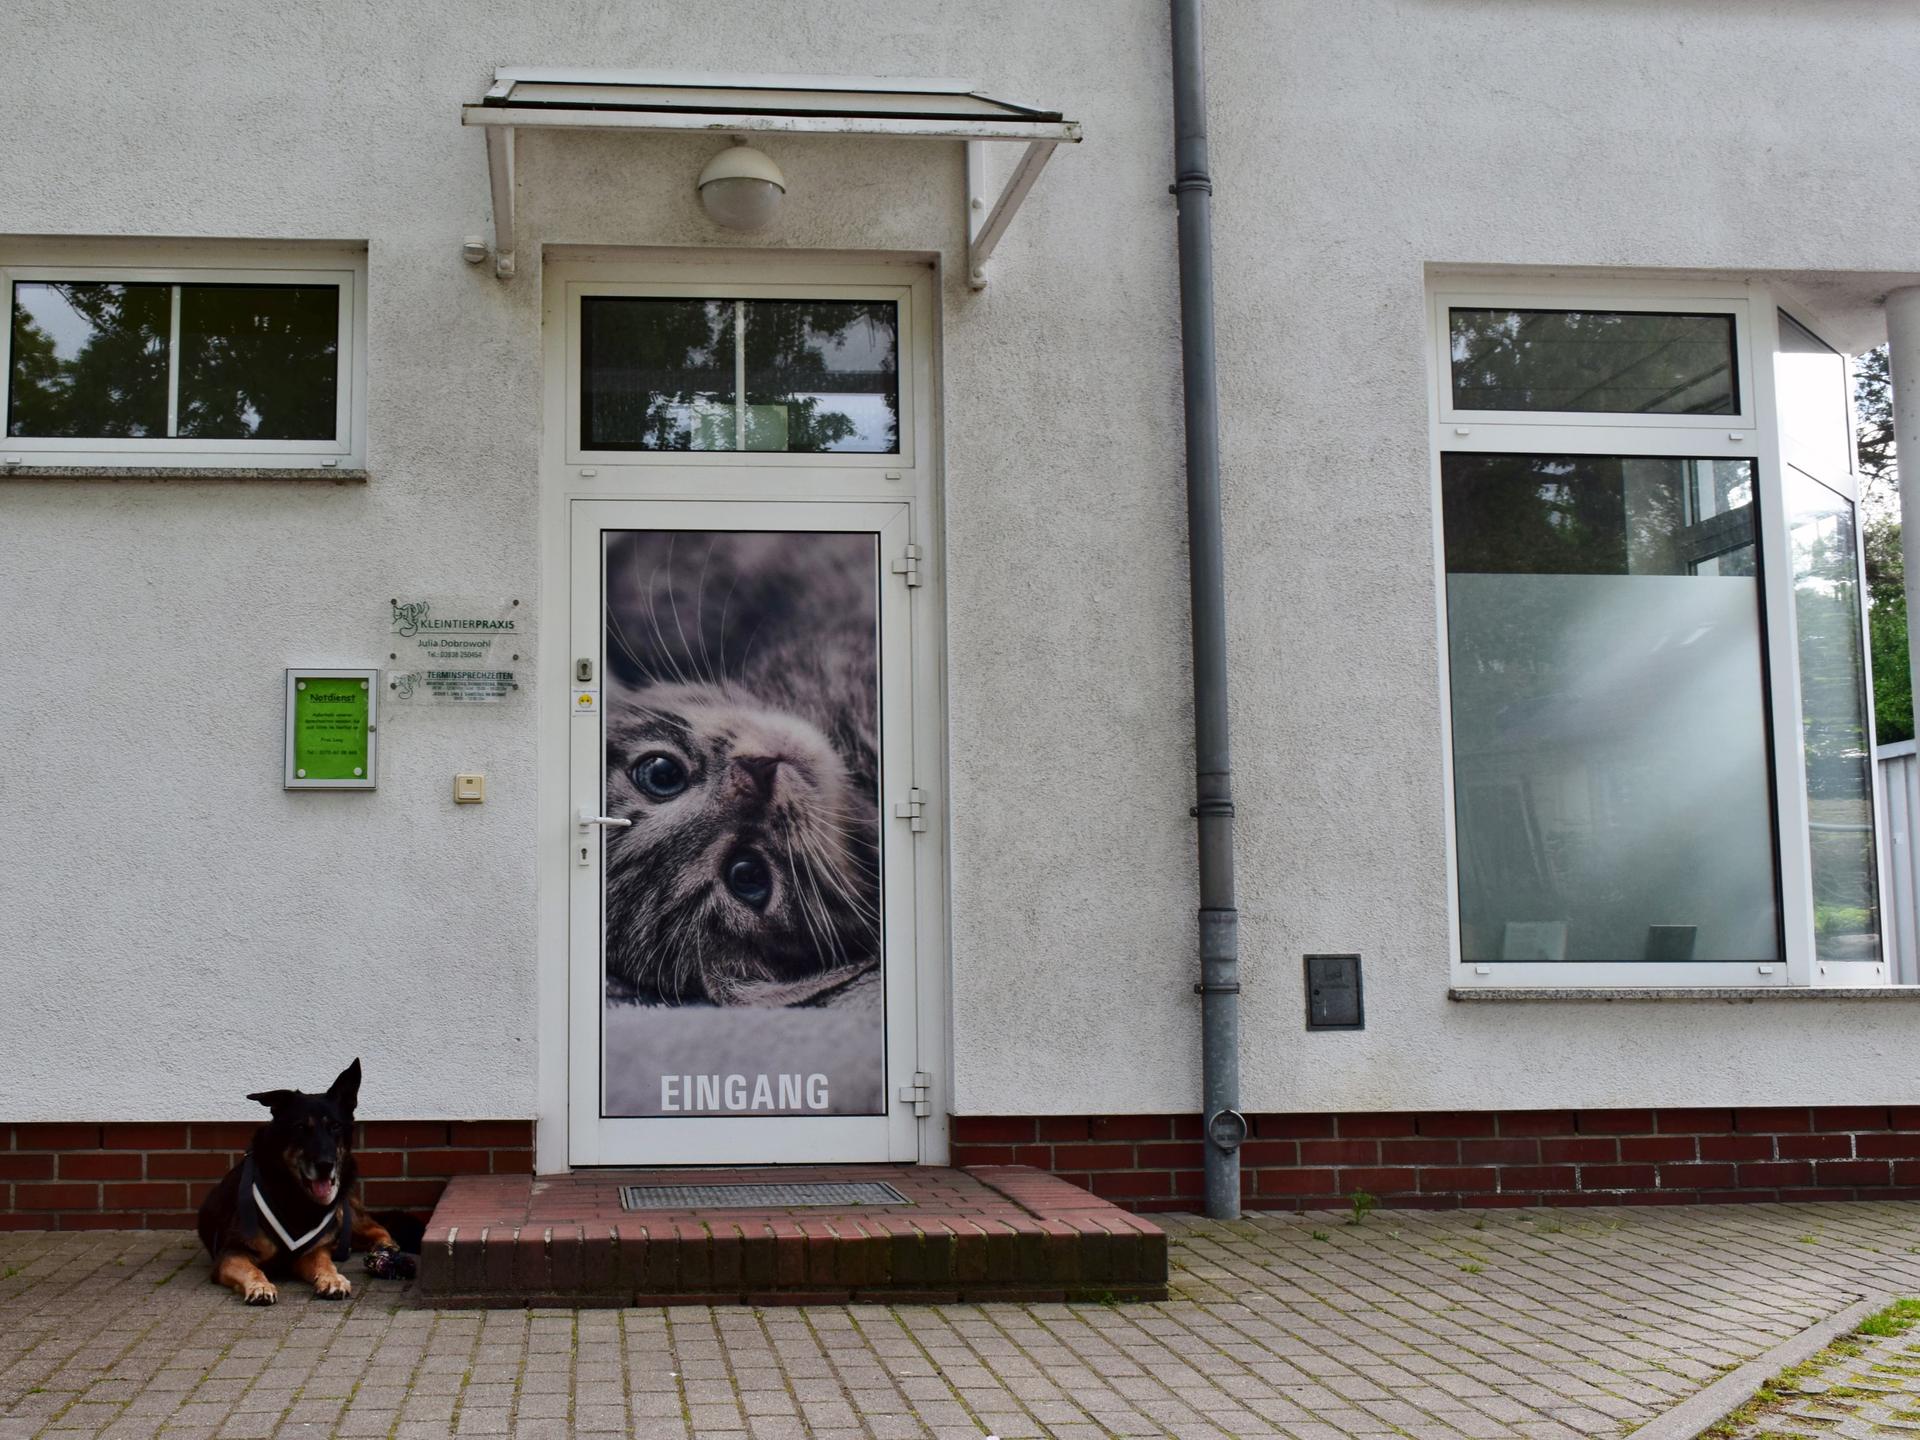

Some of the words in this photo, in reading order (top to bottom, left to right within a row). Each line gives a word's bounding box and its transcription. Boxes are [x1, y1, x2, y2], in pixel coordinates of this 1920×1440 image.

[420, 619, 515, 630] KLEINTIERPRAXIS
[418, 639, 439, 648] Julia
[441, 639, 491, 648] Dobrowohl
[427, 671, 514, 680] TERMINSPRECHZEITEN
[310, 693, 356, 702] Notdienst
[661, 1073, 829, 1111] EINGANG
